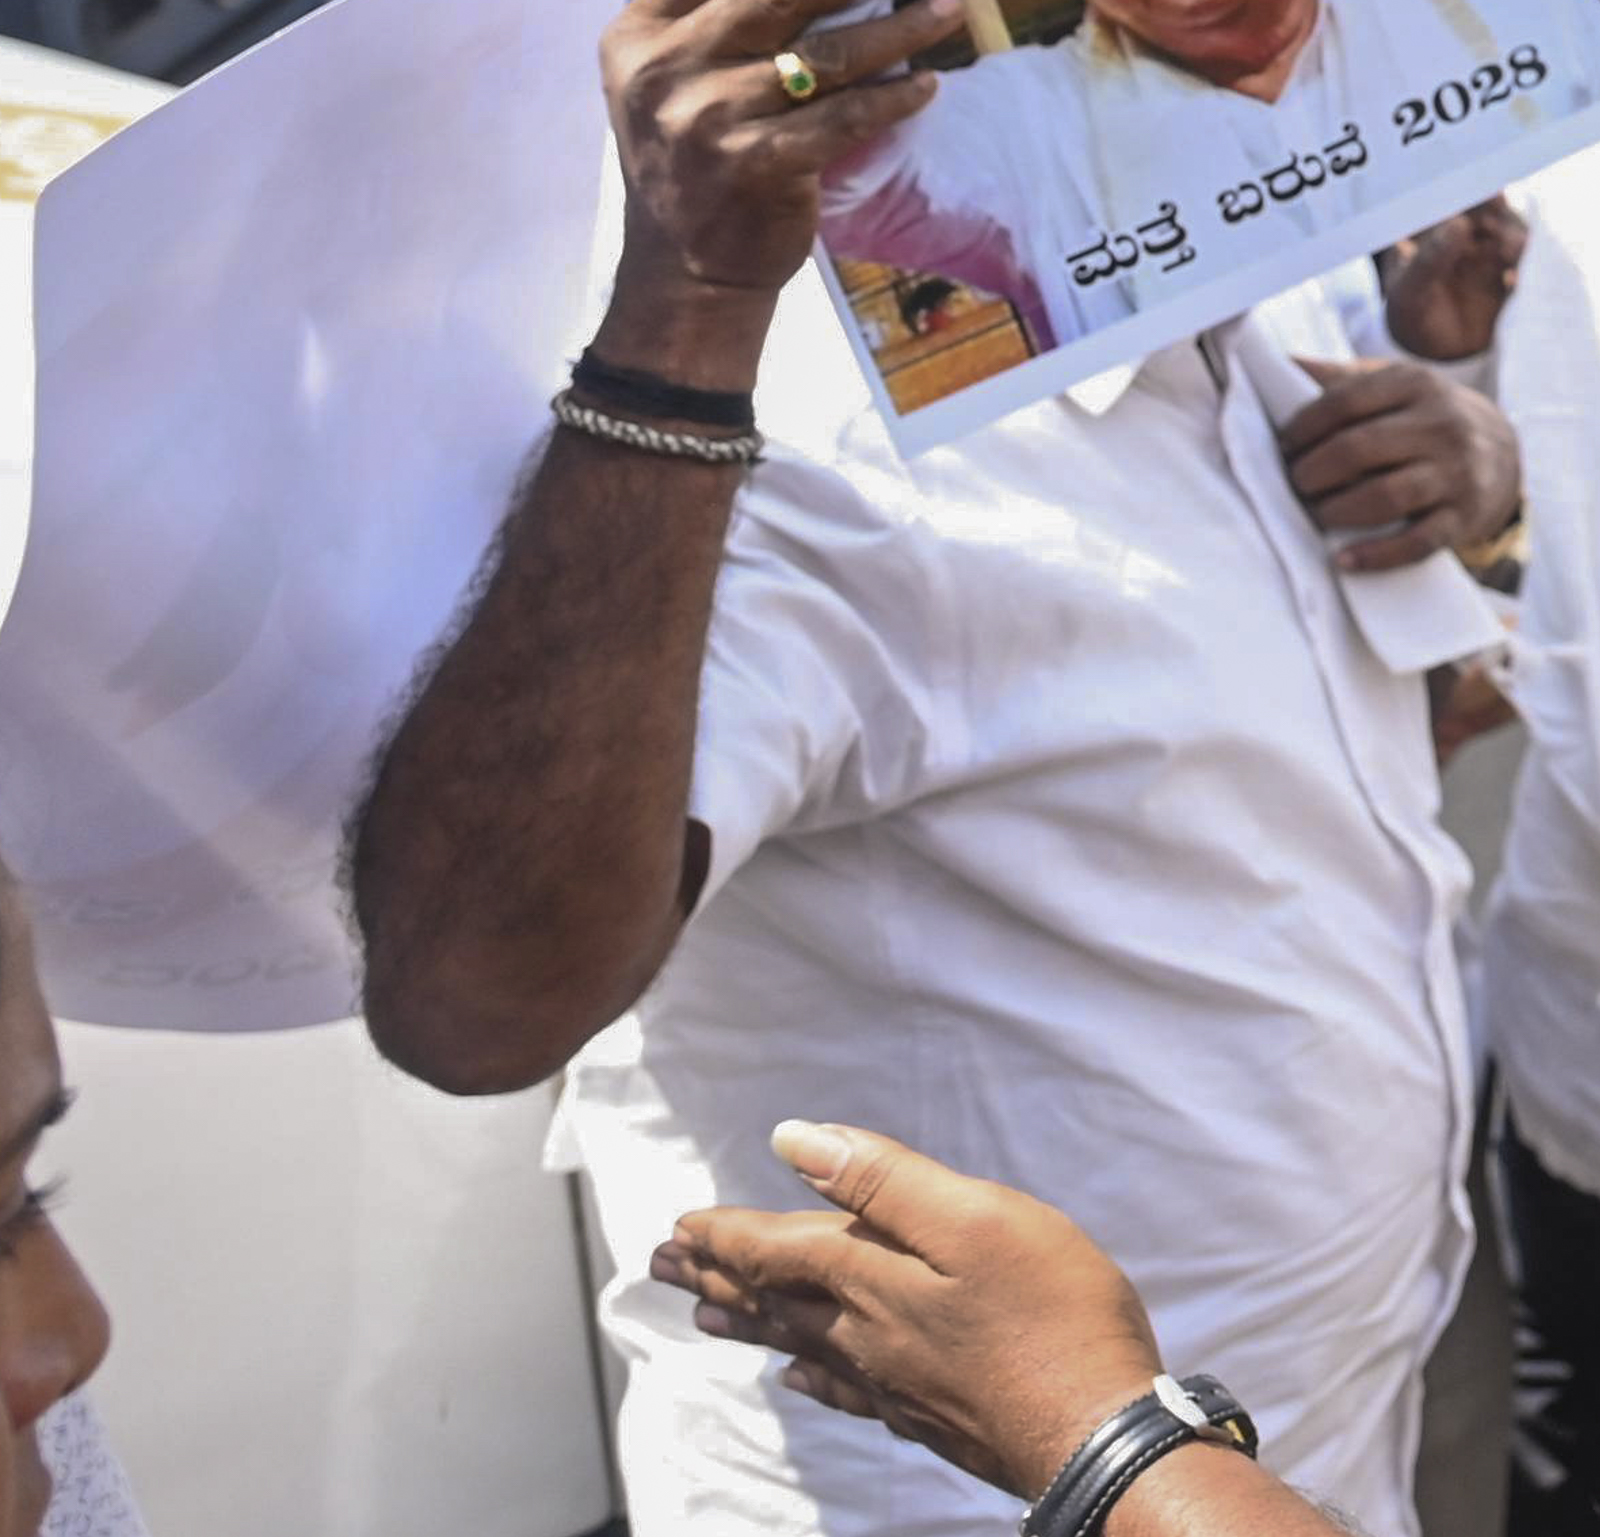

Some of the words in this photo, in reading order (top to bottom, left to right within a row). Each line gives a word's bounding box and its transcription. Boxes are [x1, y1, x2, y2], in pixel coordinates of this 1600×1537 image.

[1066, 202, 1196, 287] ಮತ್ತೆ
[1217, 122, 1369, 224] ಬರುವೆ
[1392, 44, 1548, 146] 2028
